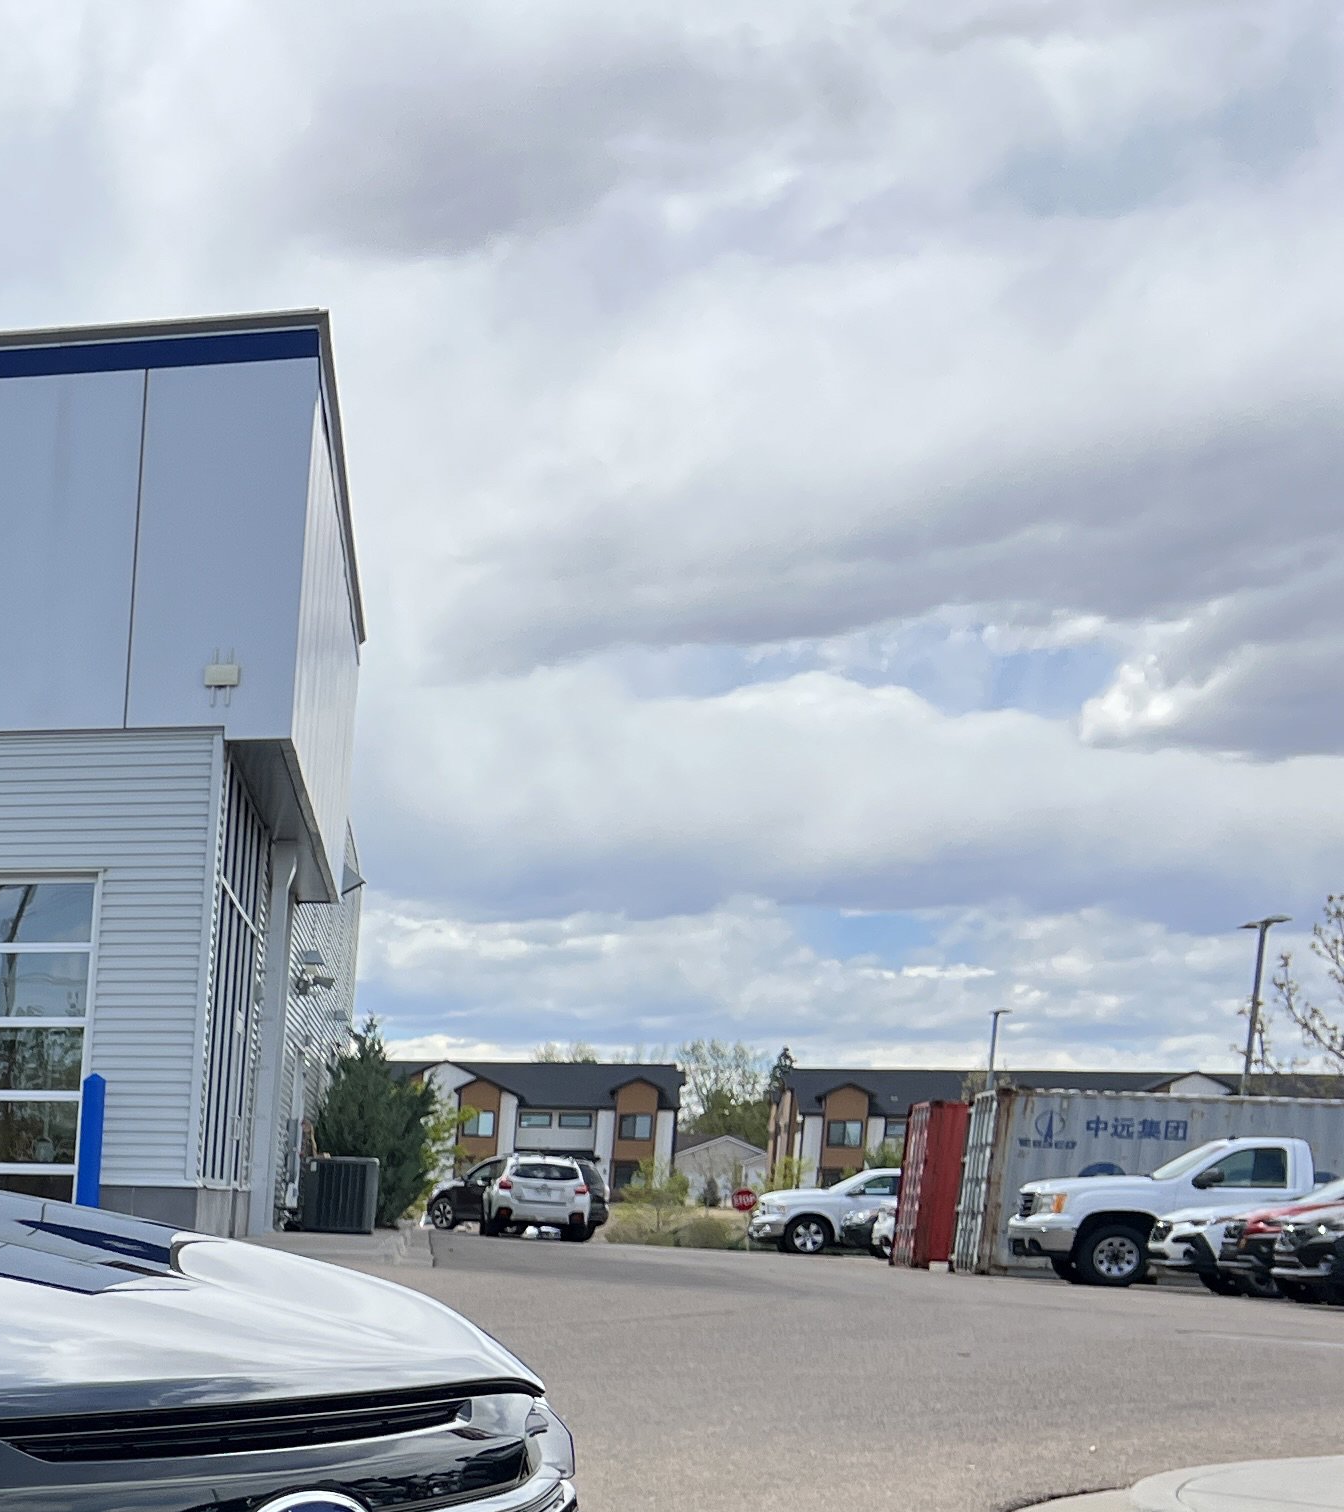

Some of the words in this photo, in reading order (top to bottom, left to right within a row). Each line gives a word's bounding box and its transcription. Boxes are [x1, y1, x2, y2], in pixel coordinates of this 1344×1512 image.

[1086, 1115, 1188, 1141] 中远集团
[733, 1194, 756, 1206] STOP
